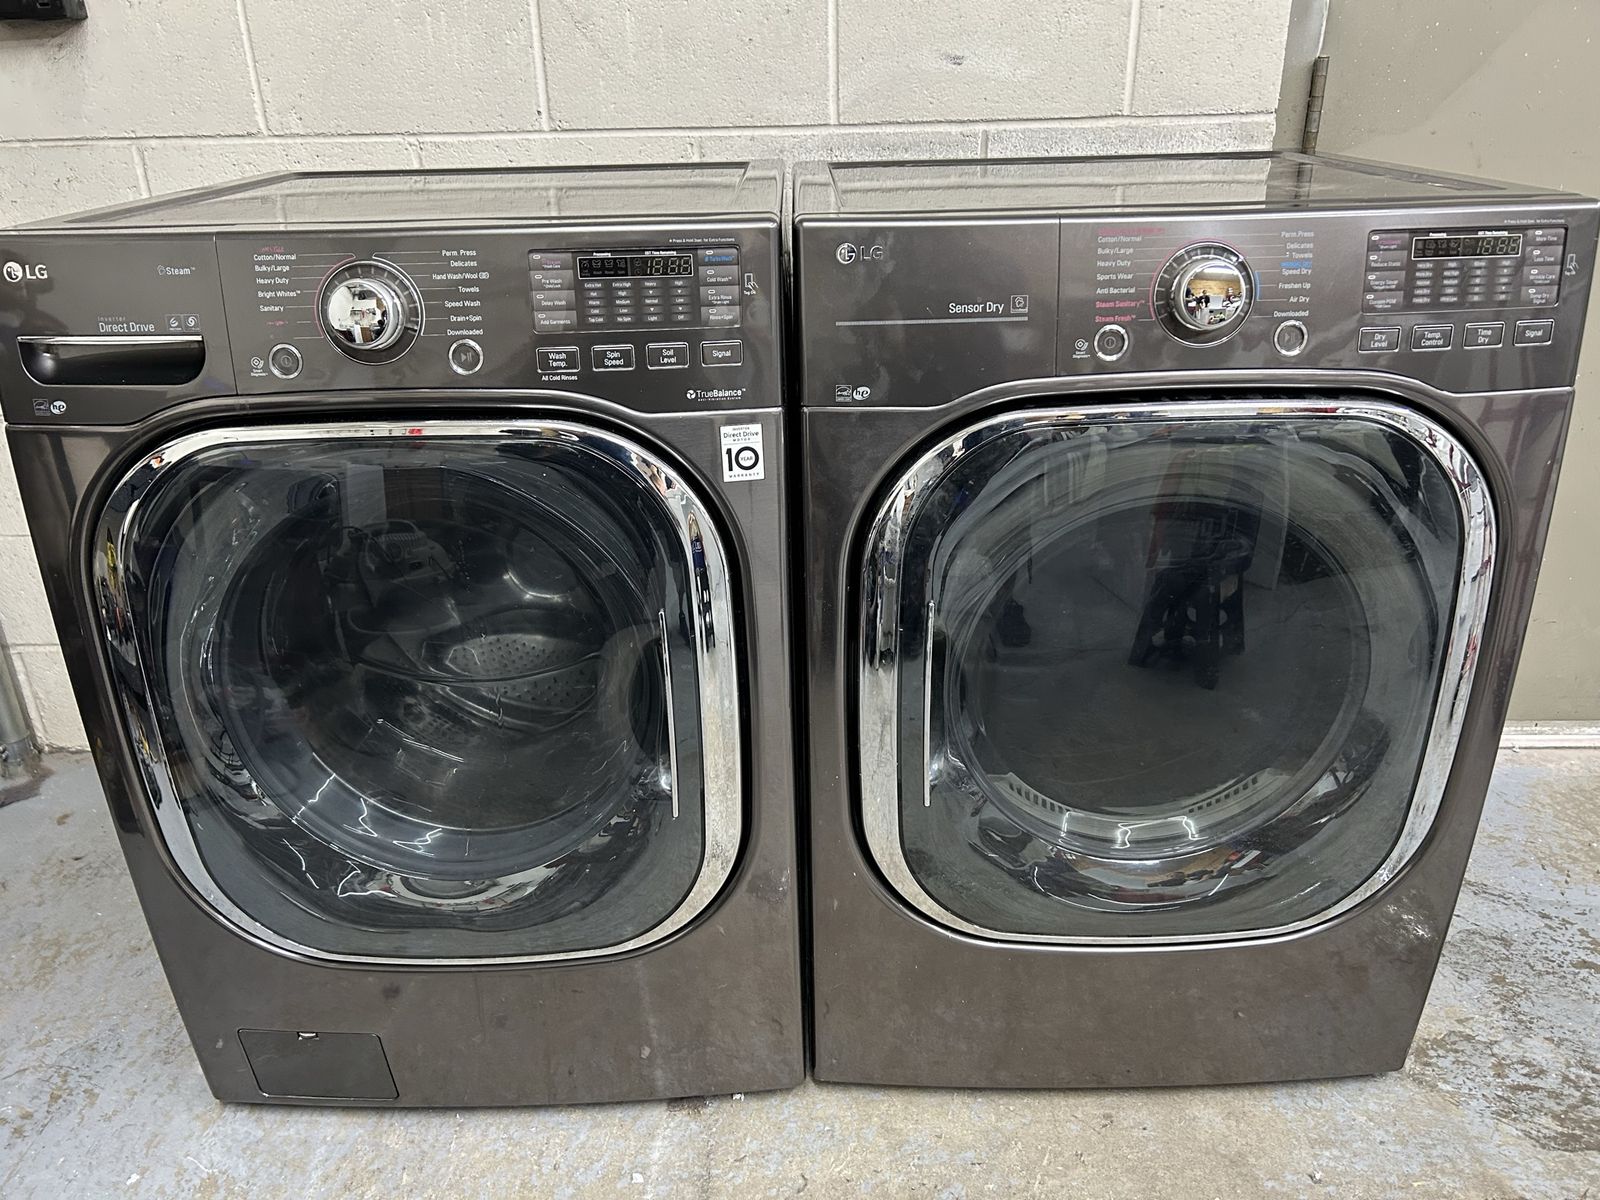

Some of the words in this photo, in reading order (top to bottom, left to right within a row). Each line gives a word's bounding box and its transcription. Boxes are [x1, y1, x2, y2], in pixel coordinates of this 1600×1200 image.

[860, 245, 883, 262] LG
[1097, 247, 1134, 255] Bulky/Large
[26, 265, 48, 279] LG
[255, 265, 289, 273] Bulky/Large
[275, 277, 289, 285] Duty
[1097, 273, 1116, 281] Sports
[1110, 286, 1135, 294] Bacterial
[1303, 282, 1311, 290] Up
[258, 291, 275, 299] Bright
[444, 300, 463, 308] Speed
[949, 302, 984, 314] Sensor
[986, 301, 1004, 314] Dry
[99, 322, 128, 332] Direct
[129, 322, 155, 332] Drive
[1424, 331, 1442, 340] Temp.
[1478, 328, 1492, 336] Time
[1525, 328, 1543, 338] Signal
[1374, 334, 1385, 342] Dry
[1421, 337, 1444, 347] Control
[1478, 336, 1489, 344] Dry
[1371, 339, 1388, 348] Level
[548, 352, 566, 360] Wash
[606, 350, 621, 359] Spin
[662, 348, 674, 356] Soil
[712, 349, 731, 358] Signal
[548, 360, 568, 368] Temp.
[604, 358, 624, 367] Speed
[660, 356, 676, 364] Level
[726, 446, 759, 472] 10
